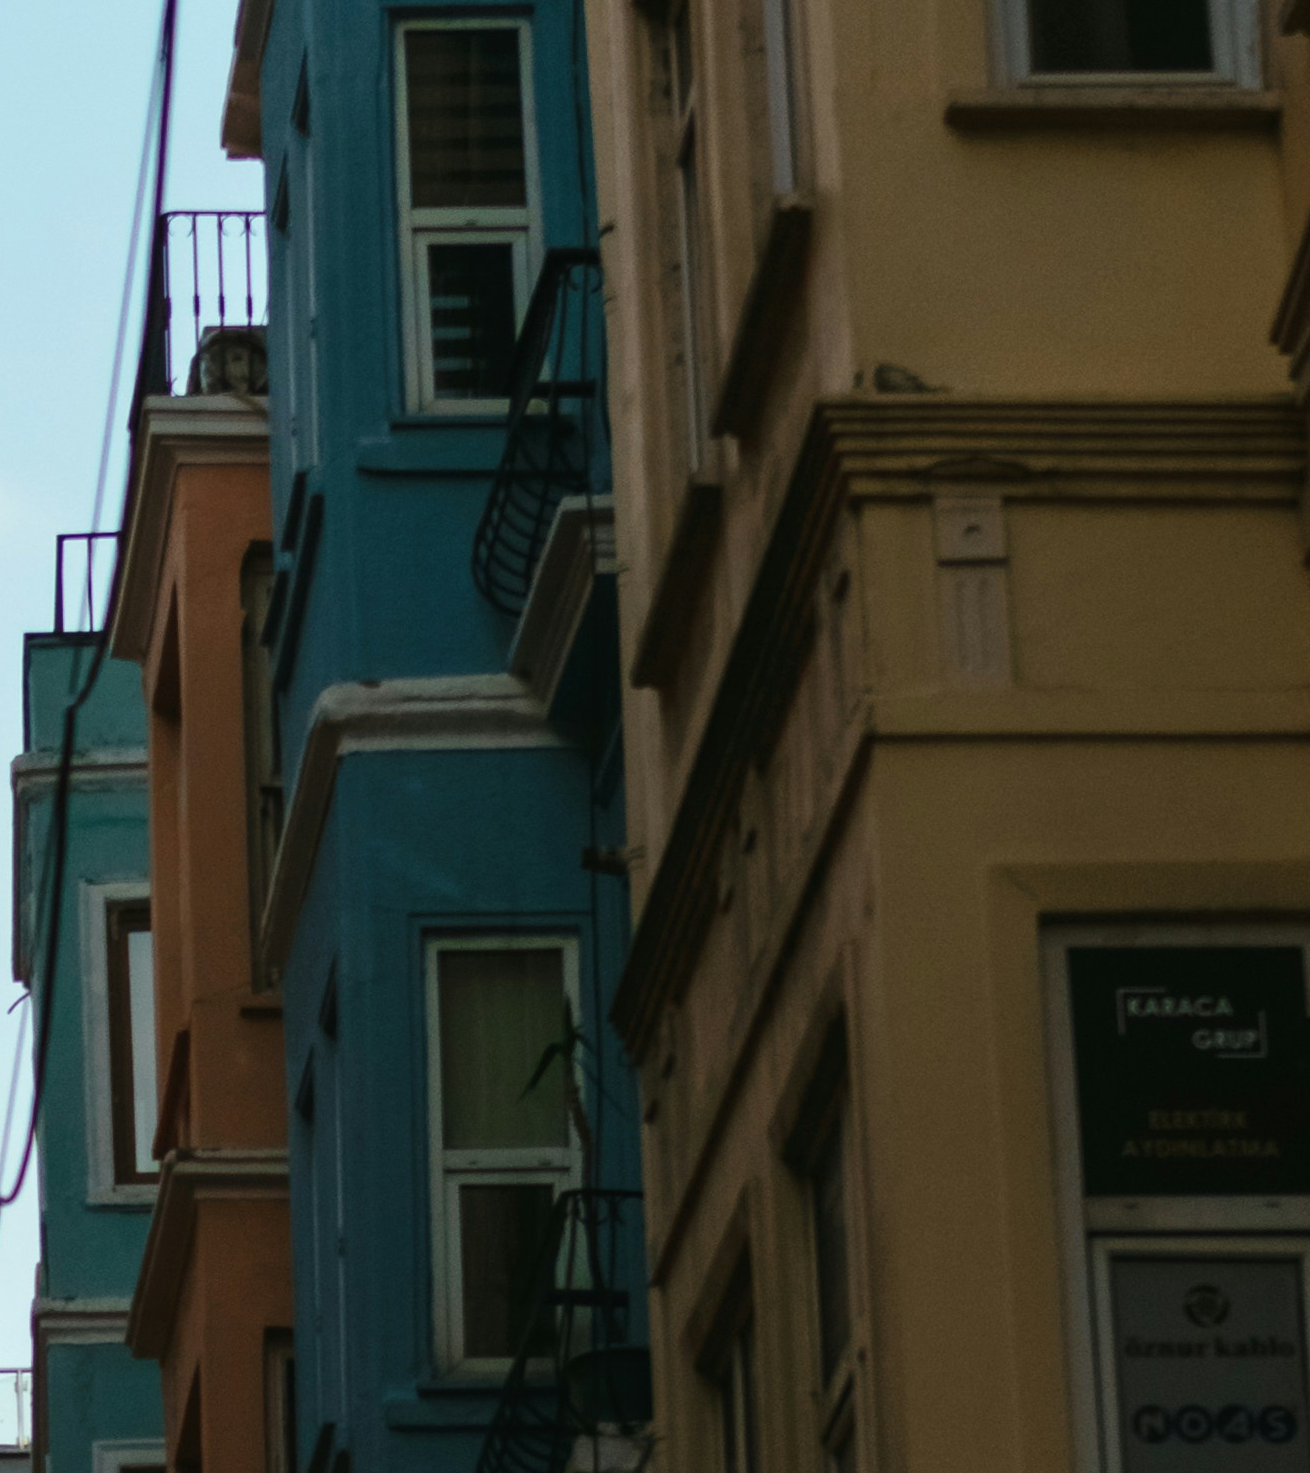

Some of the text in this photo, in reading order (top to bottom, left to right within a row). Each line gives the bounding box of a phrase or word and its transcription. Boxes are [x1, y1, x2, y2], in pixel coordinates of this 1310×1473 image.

[1127, 996, 1234, 1017] KARACA
[1191, 1029, 1257, 1050] GRUP
[1214, 1336, 1295, 1359] kablo
